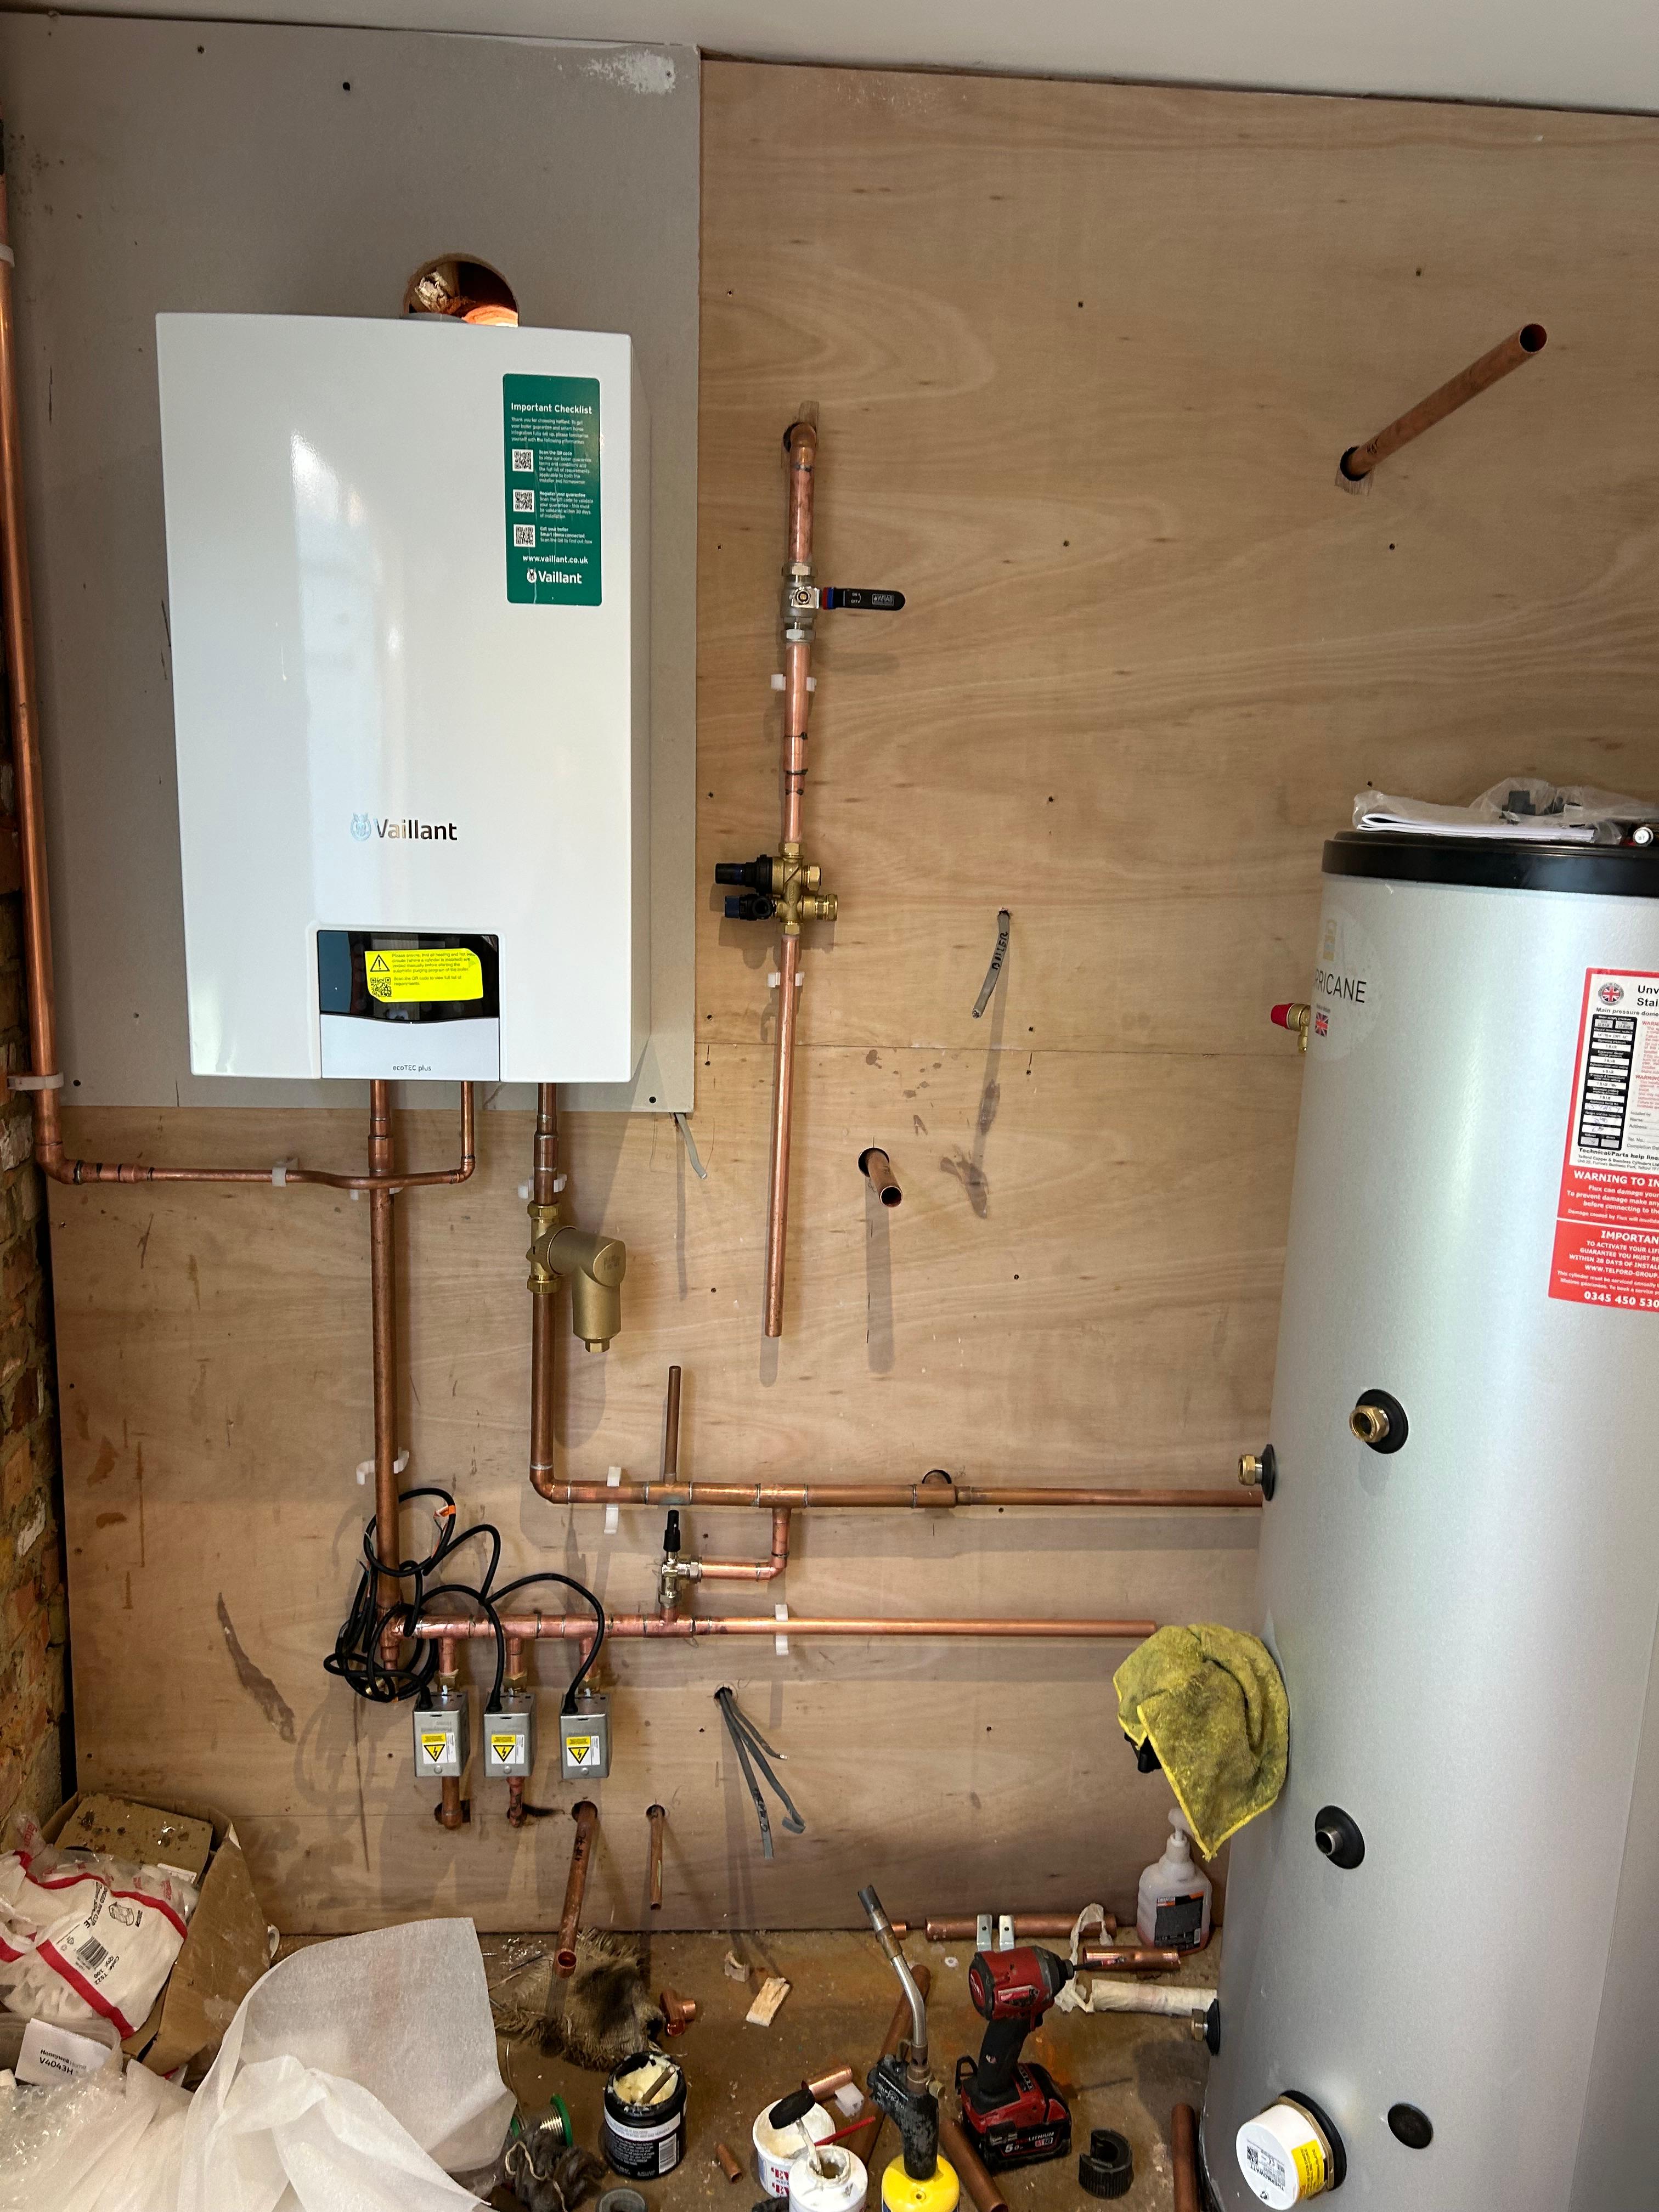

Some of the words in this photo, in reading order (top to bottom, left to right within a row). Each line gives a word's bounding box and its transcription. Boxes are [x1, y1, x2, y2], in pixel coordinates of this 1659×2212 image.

[511, 403, 552, 413] Important
[555, 404, 592, 414] Checklist
[523, 555, 588, 564] www.vaillant.co.uk
[538, 571, 582, 584] Vaillant
[373, 819, 457, 840] Vaillant
[1638, 985, 1659, 995] Unv
[1579, 1148, 1628, 1158] Technical/Parts
[1574, 1170, 1628, 1184] WARNING
[1630, 1177, 1645, 1186] TO
[1648, 1179, 1659, 1187] IN
[1617, 1188, 1643, 1197] damage
[1602, 1195, 1628, 1204] damage
[1583, 1200, 1604, 1209] before
[1605, 1204, 1640, 1214] connecting
[1601, 1231, 1659, 1244] IMPORTAN
[1596, 1242, 1627, 1251] ACTIVATE
[1579, 1248, 1617, 1257] GUARANTEE
[1569, 1254, 1594, 1262] WITHIN
[1584, 1291, 1611, 1302] 0345
[1615, 1295, 1636, 1305] 450
[40, 2057, 73, 2075] V4043H
